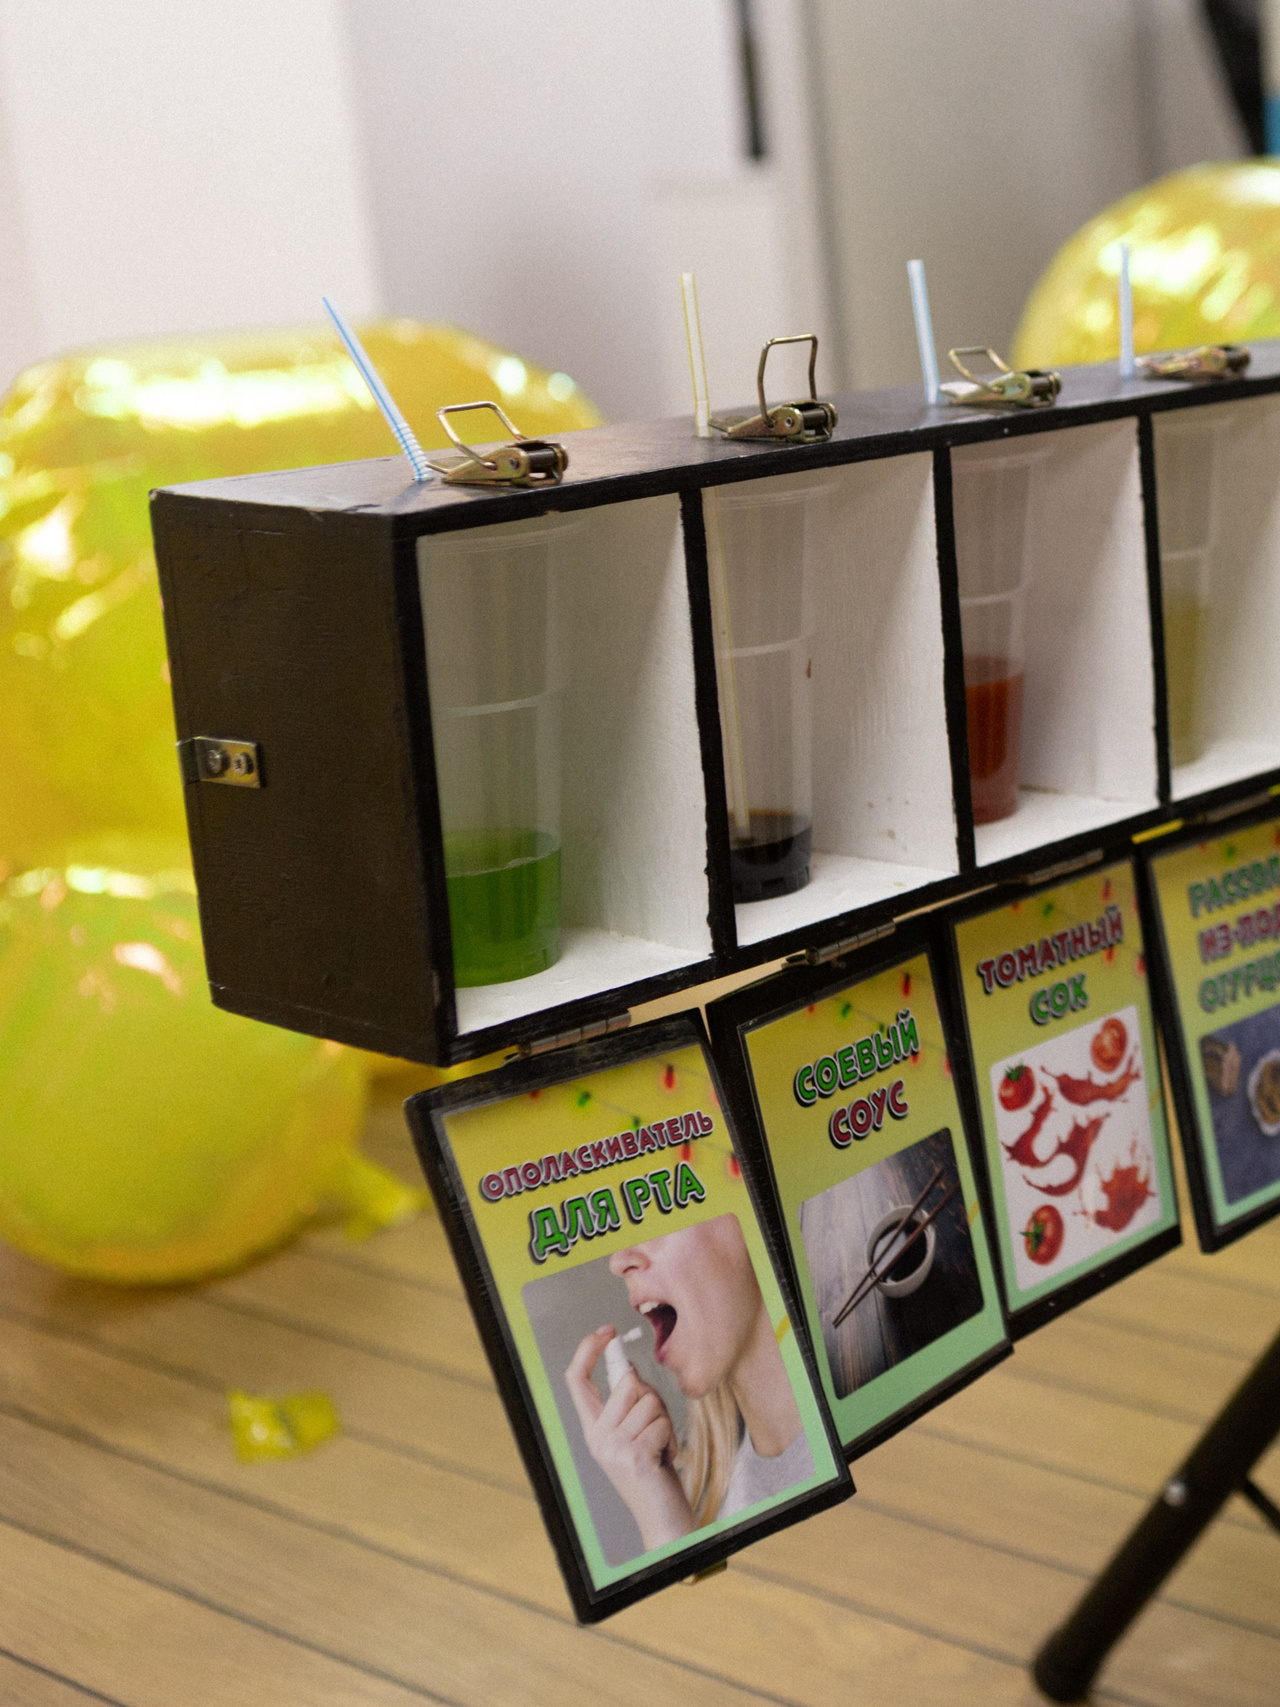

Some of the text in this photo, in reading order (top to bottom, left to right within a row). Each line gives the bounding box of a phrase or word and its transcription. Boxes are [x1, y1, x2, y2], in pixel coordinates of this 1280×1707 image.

[977, 903, 1124, 993] ТОМАТНЫЙ
[1030, 972, 1088, 1025] СОК
[794, 1009, 921, 1106] СОЕВЫЙ
[479, 1110, 714, 1201] ОПОЛАСКИВАТЕЛЬ
[829, 1080, 909, 1150] СОУС
[528, 1163, 706, 1264] ДЛЯ РТА
